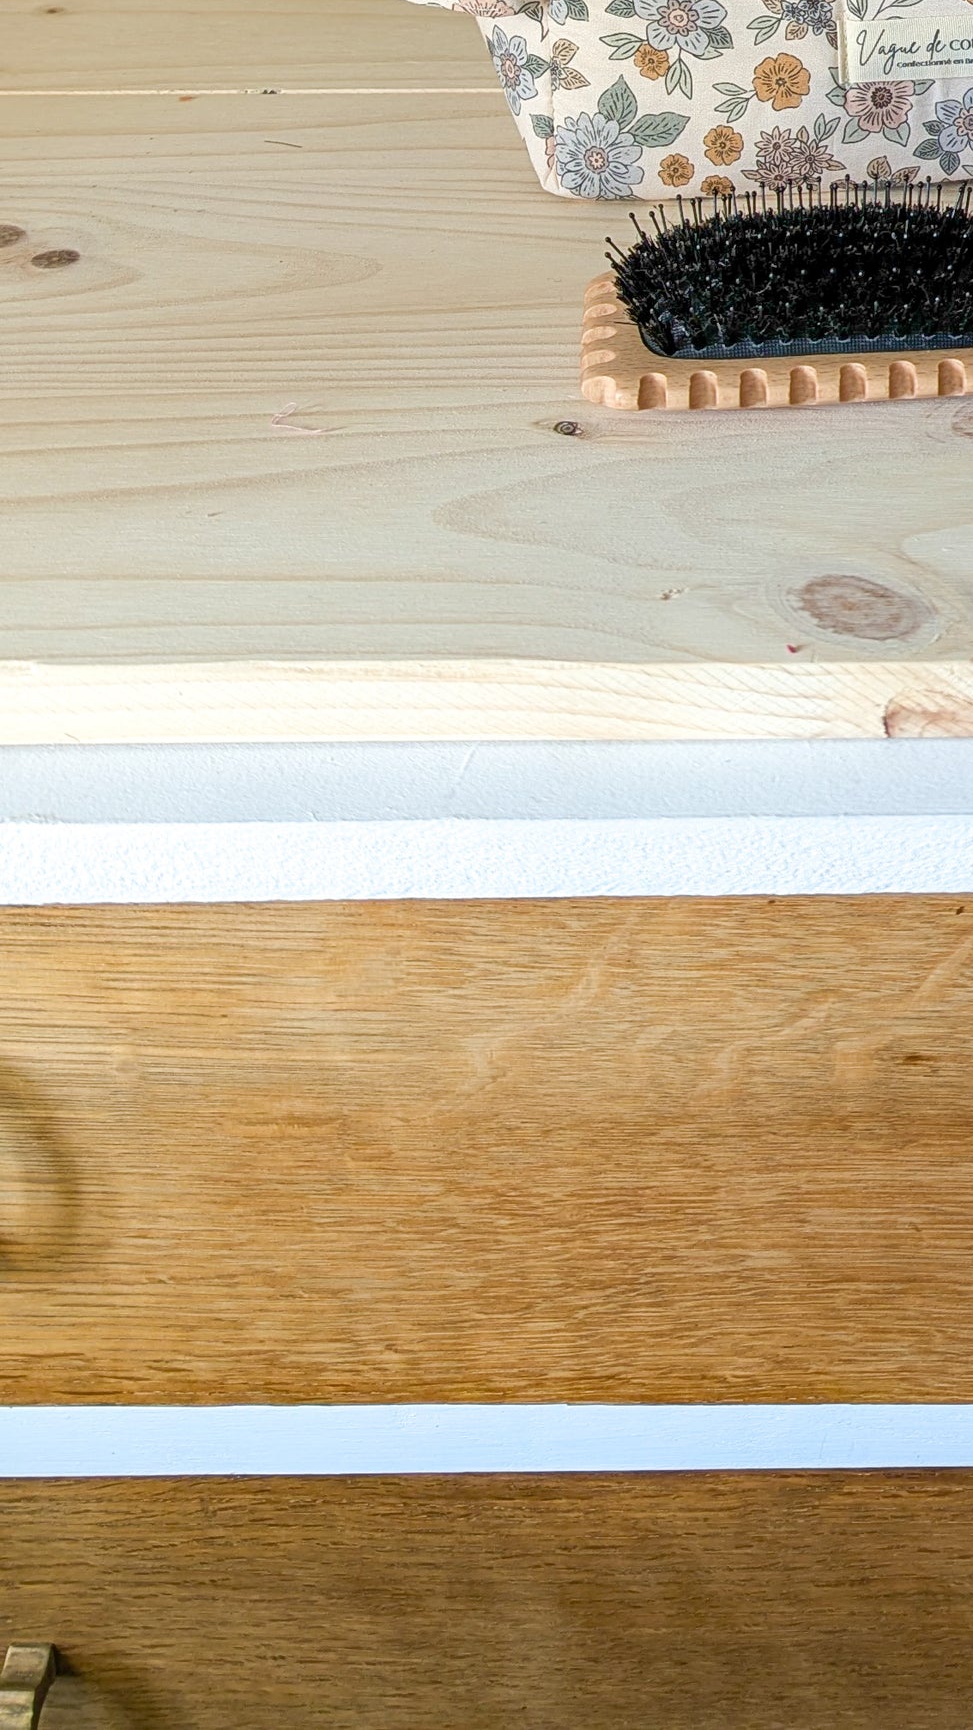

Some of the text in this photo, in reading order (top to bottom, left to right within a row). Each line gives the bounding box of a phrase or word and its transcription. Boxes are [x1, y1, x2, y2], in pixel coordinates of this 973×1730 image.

[857, 28, 921, 75] Vague
[926, 28, 947, 59] de
[896, 59, 951, 68] Confectionné
